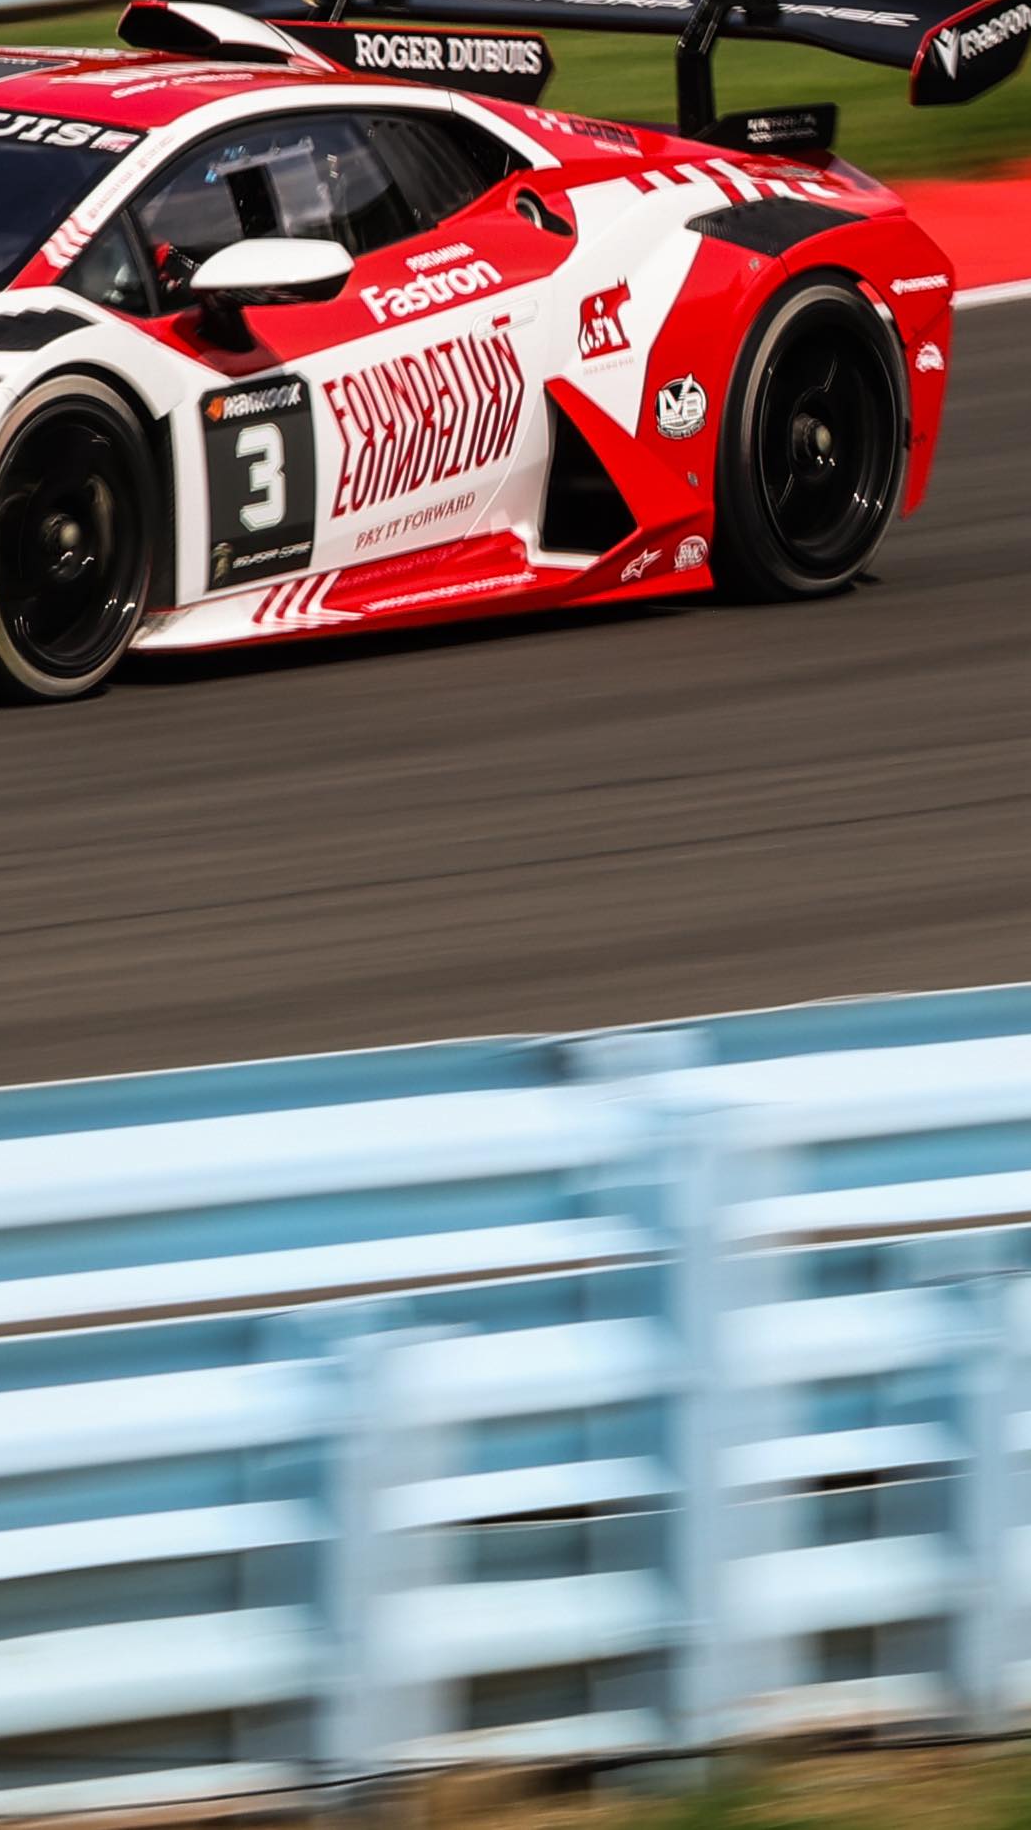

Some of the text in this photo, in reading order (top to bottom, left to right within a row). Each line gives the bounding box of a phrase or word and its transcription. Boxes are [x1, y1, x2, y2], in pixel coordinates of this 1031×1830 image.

[354, 33, 543, 75] ROGER DUBUIS
[359, 259, 503, 324] Fastron
[235, 422, 287, 532] 3
[355, 491, 476, 552] PAY IT FORWARD
